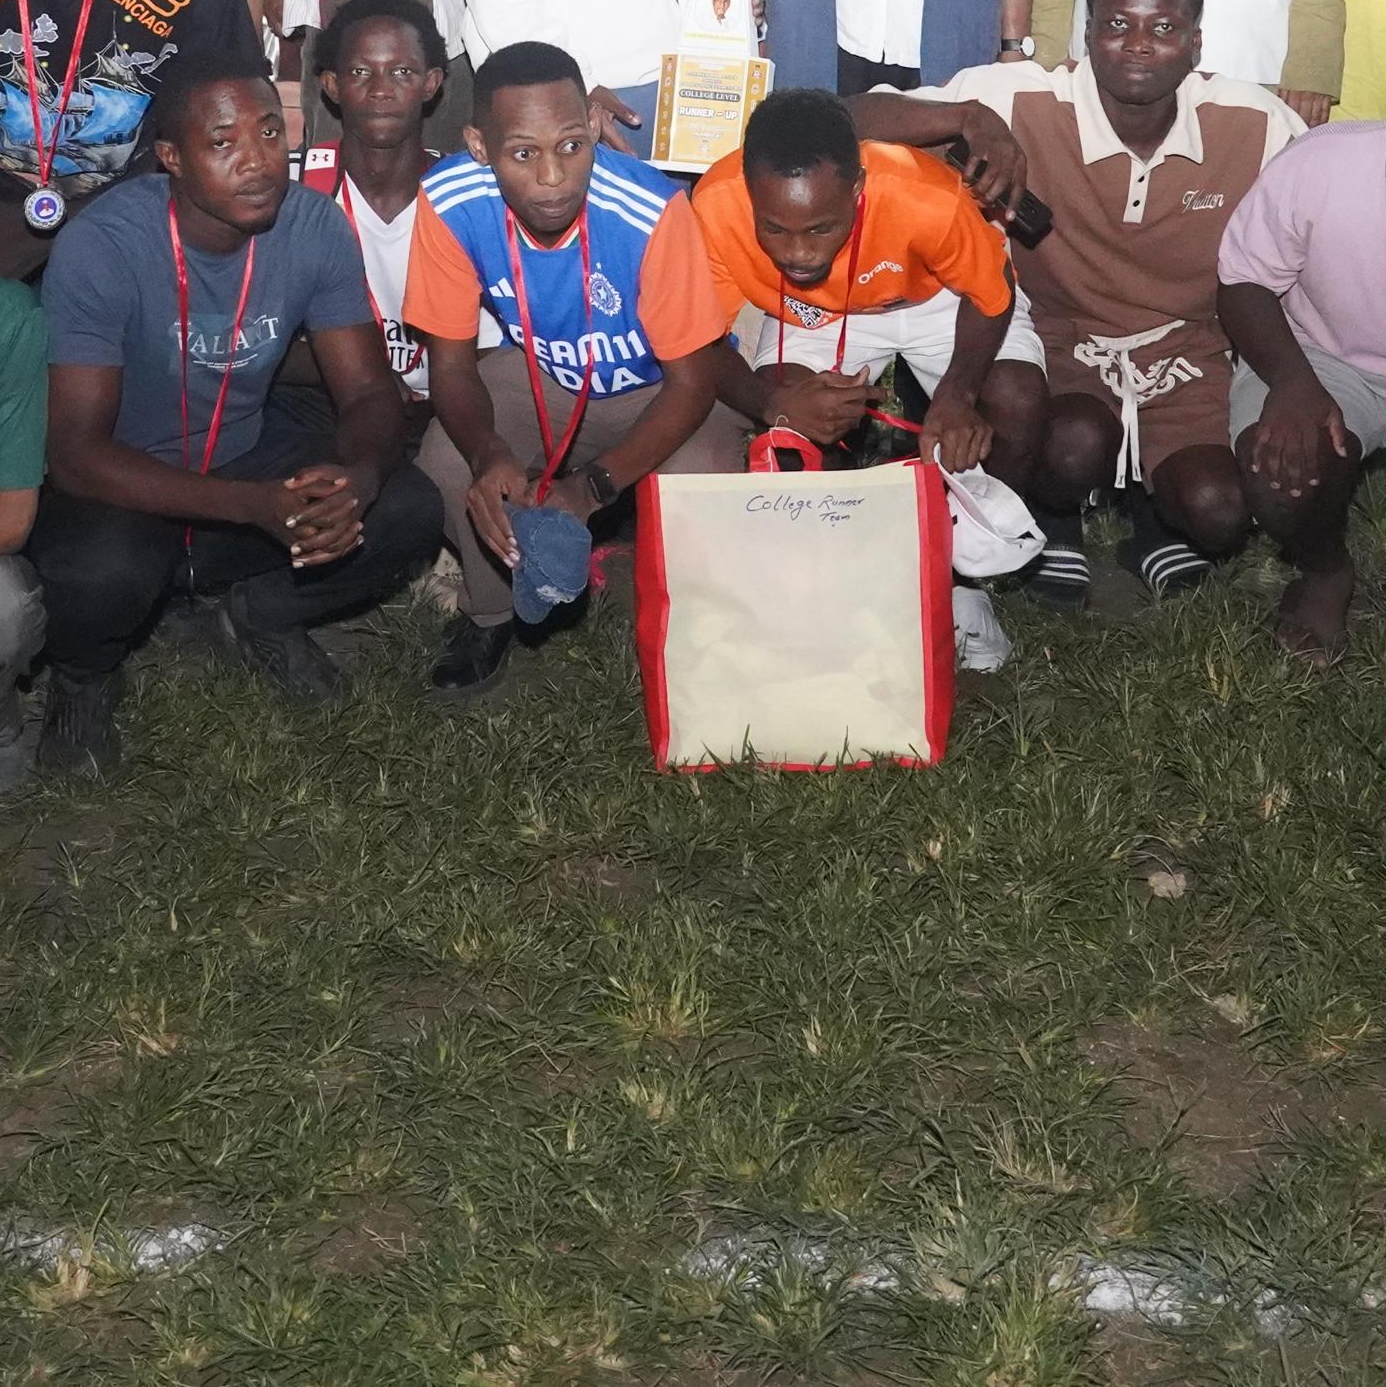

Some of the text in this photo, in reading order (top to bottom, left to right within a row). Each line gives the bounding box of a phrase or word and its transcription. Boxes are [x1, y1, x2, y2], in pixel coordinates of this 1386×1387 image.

[715, 93, 739, 102] LEVEL
[858, 260, 904, 284] Orange
[745, 494, 813, 521] College
